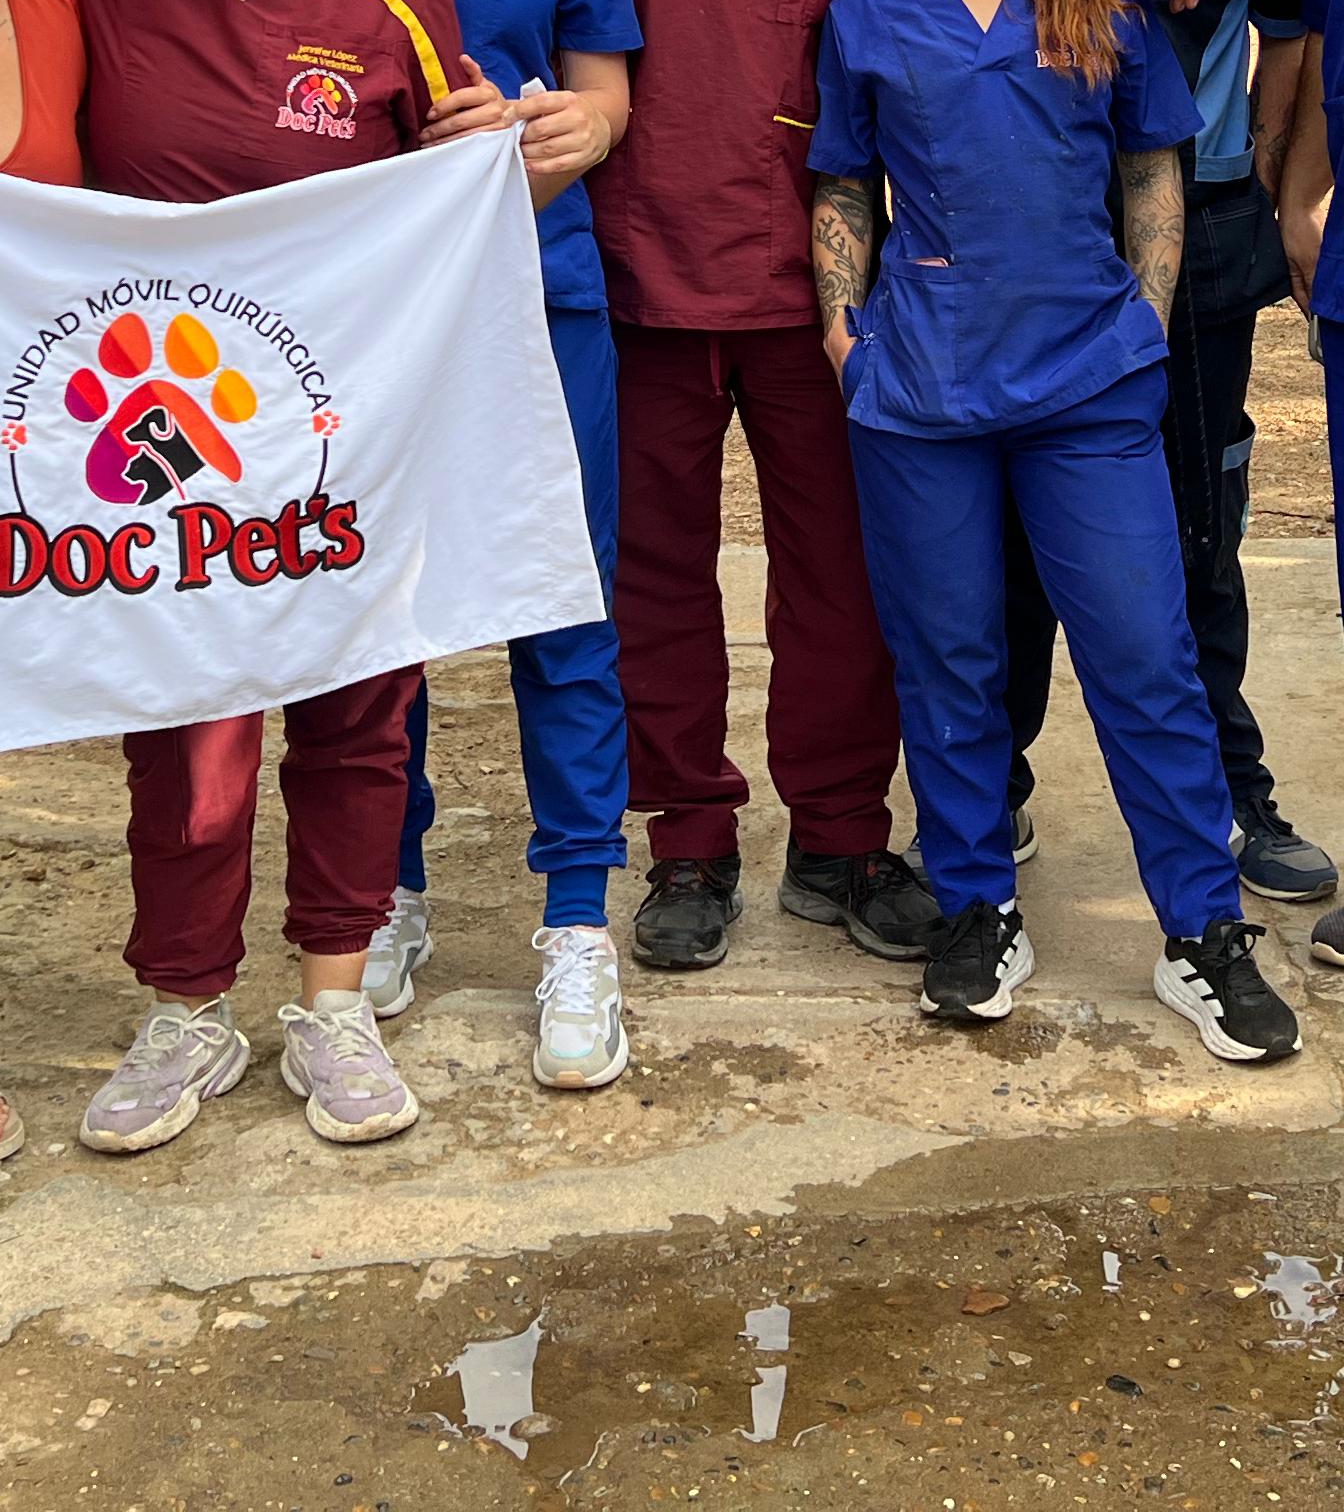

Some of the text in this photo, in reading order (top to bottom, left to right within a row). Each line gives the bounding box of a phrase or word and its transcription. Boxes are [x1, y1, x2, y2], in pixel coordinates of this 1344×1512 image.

[275, 106, 316, 133] Doc
[2, 277, 332, 421] UNIDAD MÓVIL QUIRÚRGICA
[168, 492, 365, 592] Pet's
